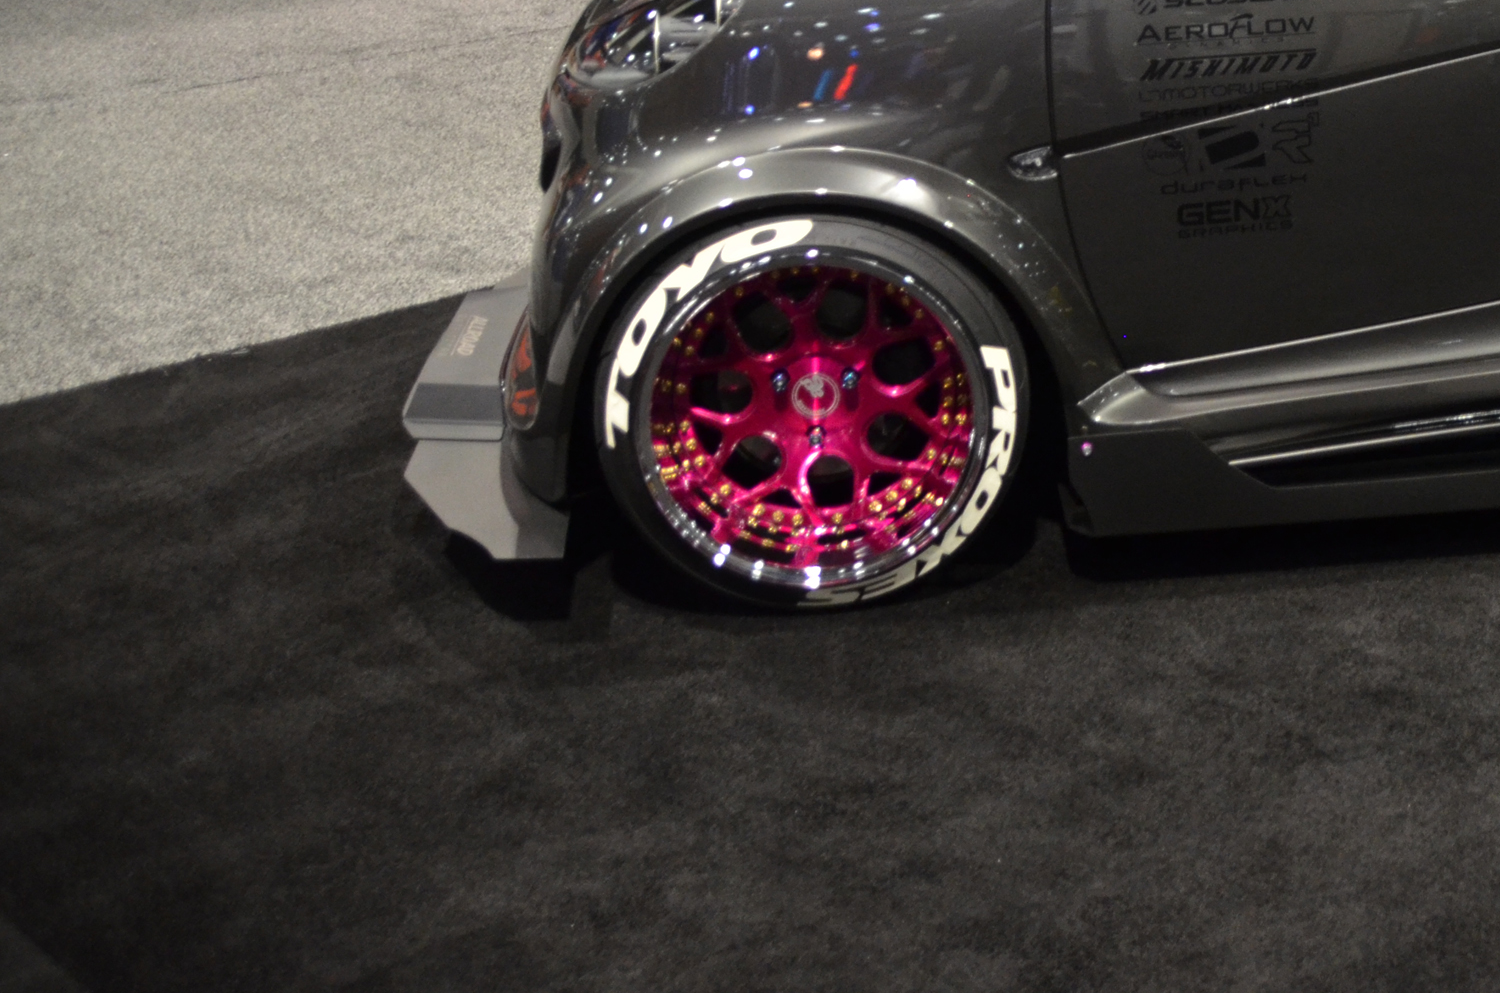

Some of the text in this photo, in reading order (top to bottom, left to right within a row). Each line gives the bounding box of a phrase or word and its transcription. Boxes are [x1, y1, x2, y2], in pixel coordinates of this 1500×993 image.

[1139, 50, 1317, 82] MISHIMOTO
[1177, 219, 1294, 239] GRAPHICS
[605, 218, 814, 449] TOYO
[796, 344, 1019, 607] PROXES
